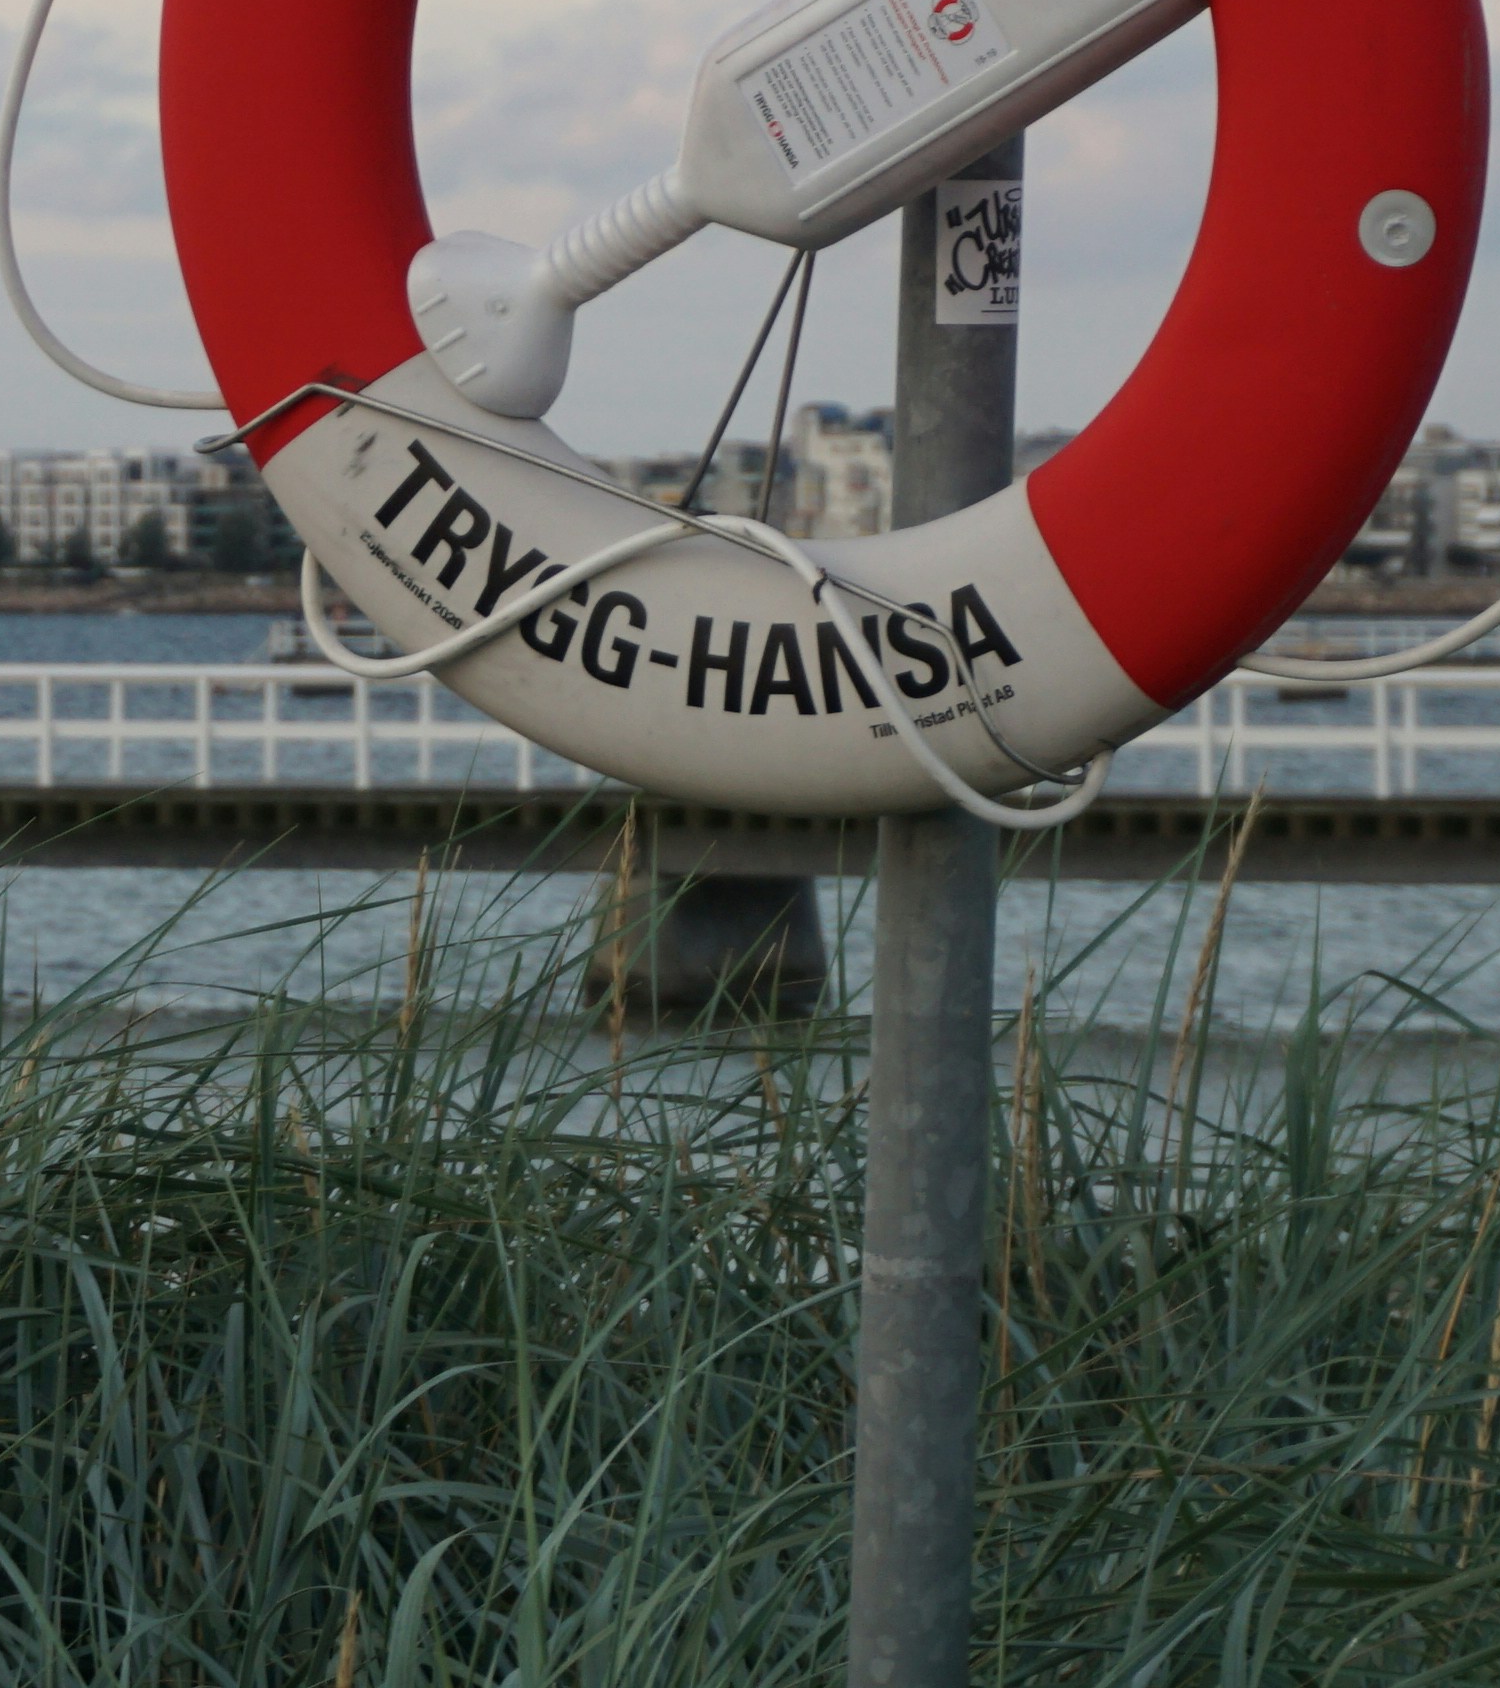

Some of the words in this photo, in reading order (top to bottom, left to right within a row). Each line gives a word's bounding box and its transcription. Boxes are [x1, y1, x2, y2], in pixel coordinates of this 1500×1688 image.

[989, 286, 1019, 305] LU
[373, 438, 1024, 716] TRYGG-HANSA
[431, 599, 464, 631] 2020
[994, 683, 1016, 704] AB
